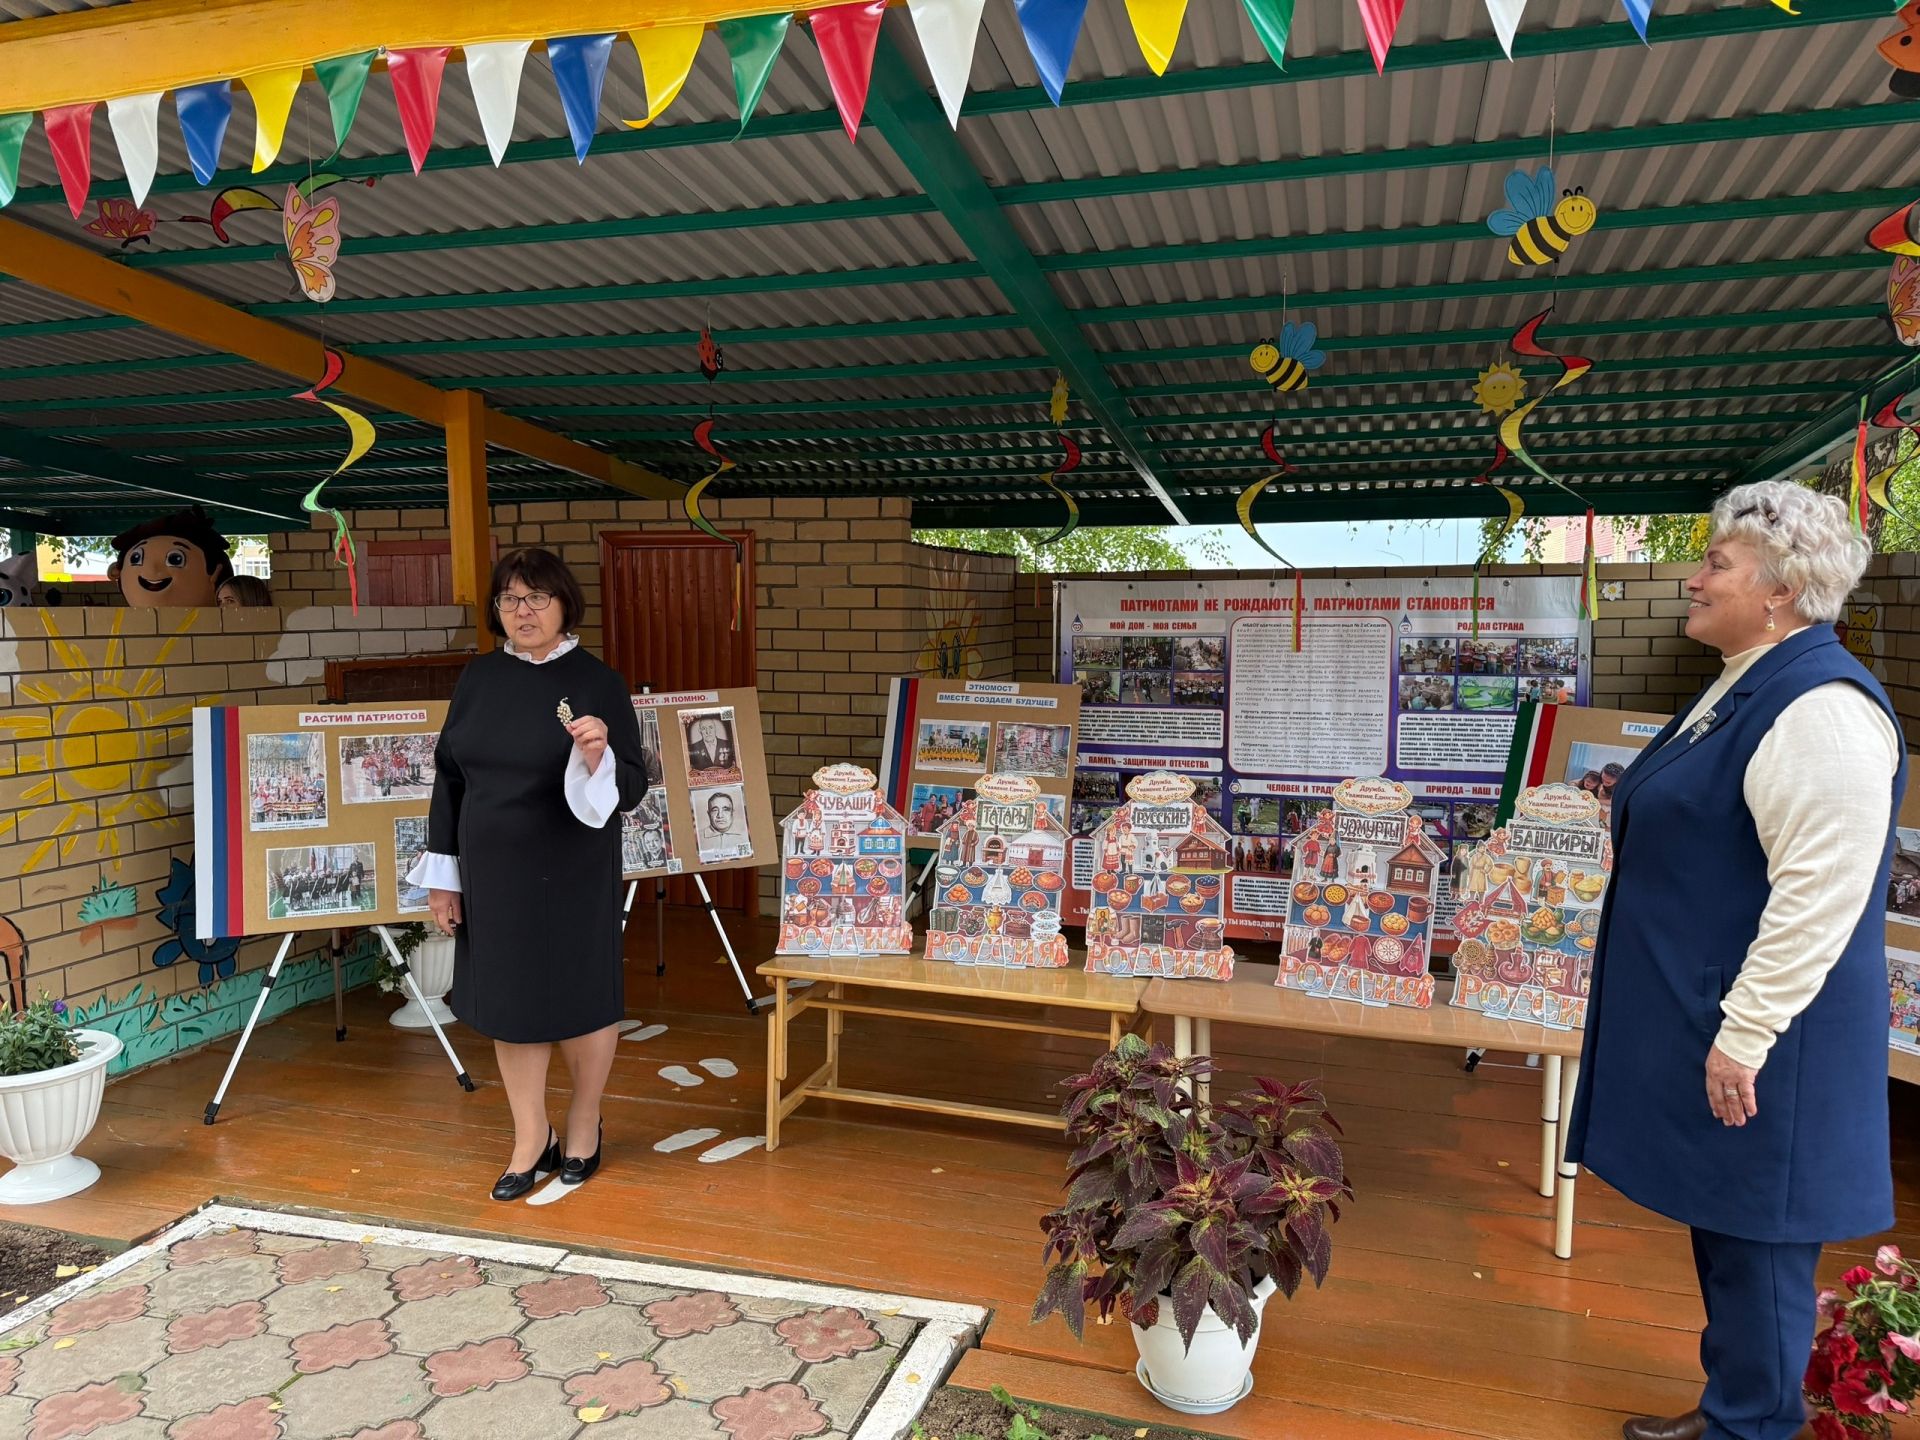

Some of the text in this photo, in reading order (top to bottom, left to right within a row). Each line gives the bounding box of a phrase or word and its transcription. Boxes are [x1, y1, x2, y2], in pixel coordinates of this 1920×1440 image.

[1120, 598, 1199, 612] ПАТРИОТАМИ
[1203, 599, 1219, 611] НЕ
[1313, 597, 1401, 610] ПАТРИОТАМИ
[1406, 597, 1495, 610] СТАНОВЯТСЯ
[1109, 621, 1125, 630] МОЙ
[1128, 621, 1145, 631] ДОМ
[1152, 621, 1169, 630] МОЯ
[1172, 621, 1197, 630] СЕМЬЯ
[1492, 622, 1525, 631] СТРАНА
[969, 683, 1013, 692] ЭТНОМОСТ
[939, 694, 1054, 706] ВМЕСТЕ СОЗДАЕМ БУДУЩЕЕ
[304, 712, 426, 723] РАСТИМ ПАТРИОТОВ
[1088, 757, 1116, 765] ПАМЯТЬ
[1123, 758, 1166, 768] ЗАЩИТНИКИ
[1169, 760, 1209, 769] ОТЕЧЕСТВА
[1266, 783, 1300, 793] ЧЕЛОВЕК
[1303, 785, 1309, 793] И
[1426, 785, 1464, 795] ПРИРОДА
[1472, 786, 1491, 796] НАШ
[819, 796, 872, 811] ЧУВАШИ
[984, 806, 1029, 829] ТАТАРЫ
[1137, 812, 1186, 825] РУССКИЕ
[1339, 818, 1400, 839] УДМУРТЫ
[1512, 829, 1595, 853] БАШКИРЫ
[923, 930, 1058, 968] РОССИЯ
[1084, 941, 1221, 979] РОССИЯ
[1274, 955, 1420, 1004] РОССИЯ
[1455, 973, 1586, 1027] РОССИ
